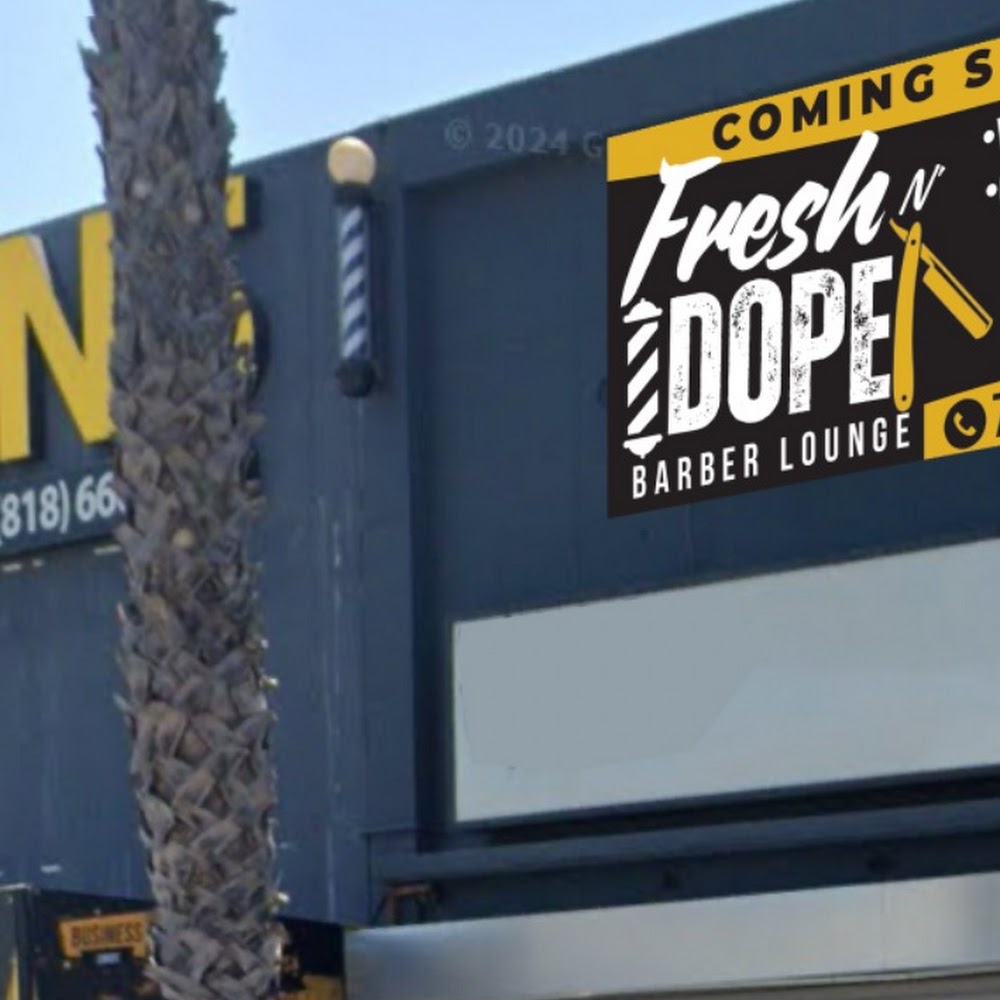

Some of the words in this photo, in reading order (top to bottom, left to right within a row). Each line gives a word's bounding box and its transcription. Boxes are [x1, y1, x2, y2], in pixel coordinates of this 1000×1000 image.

[713, 64, 933, 150] COMING
[621, 129, 889, 308] Fresh
[668, 255, 894, 436] DOPE
[632, 442, 759, 500] BARBER
[780, 412, 910, 472] LOUNGE
[0, 479, 70, 546] 818)
[75, 470, 127, 522] 66
[71, 920, 143, 948] BUSINESS
